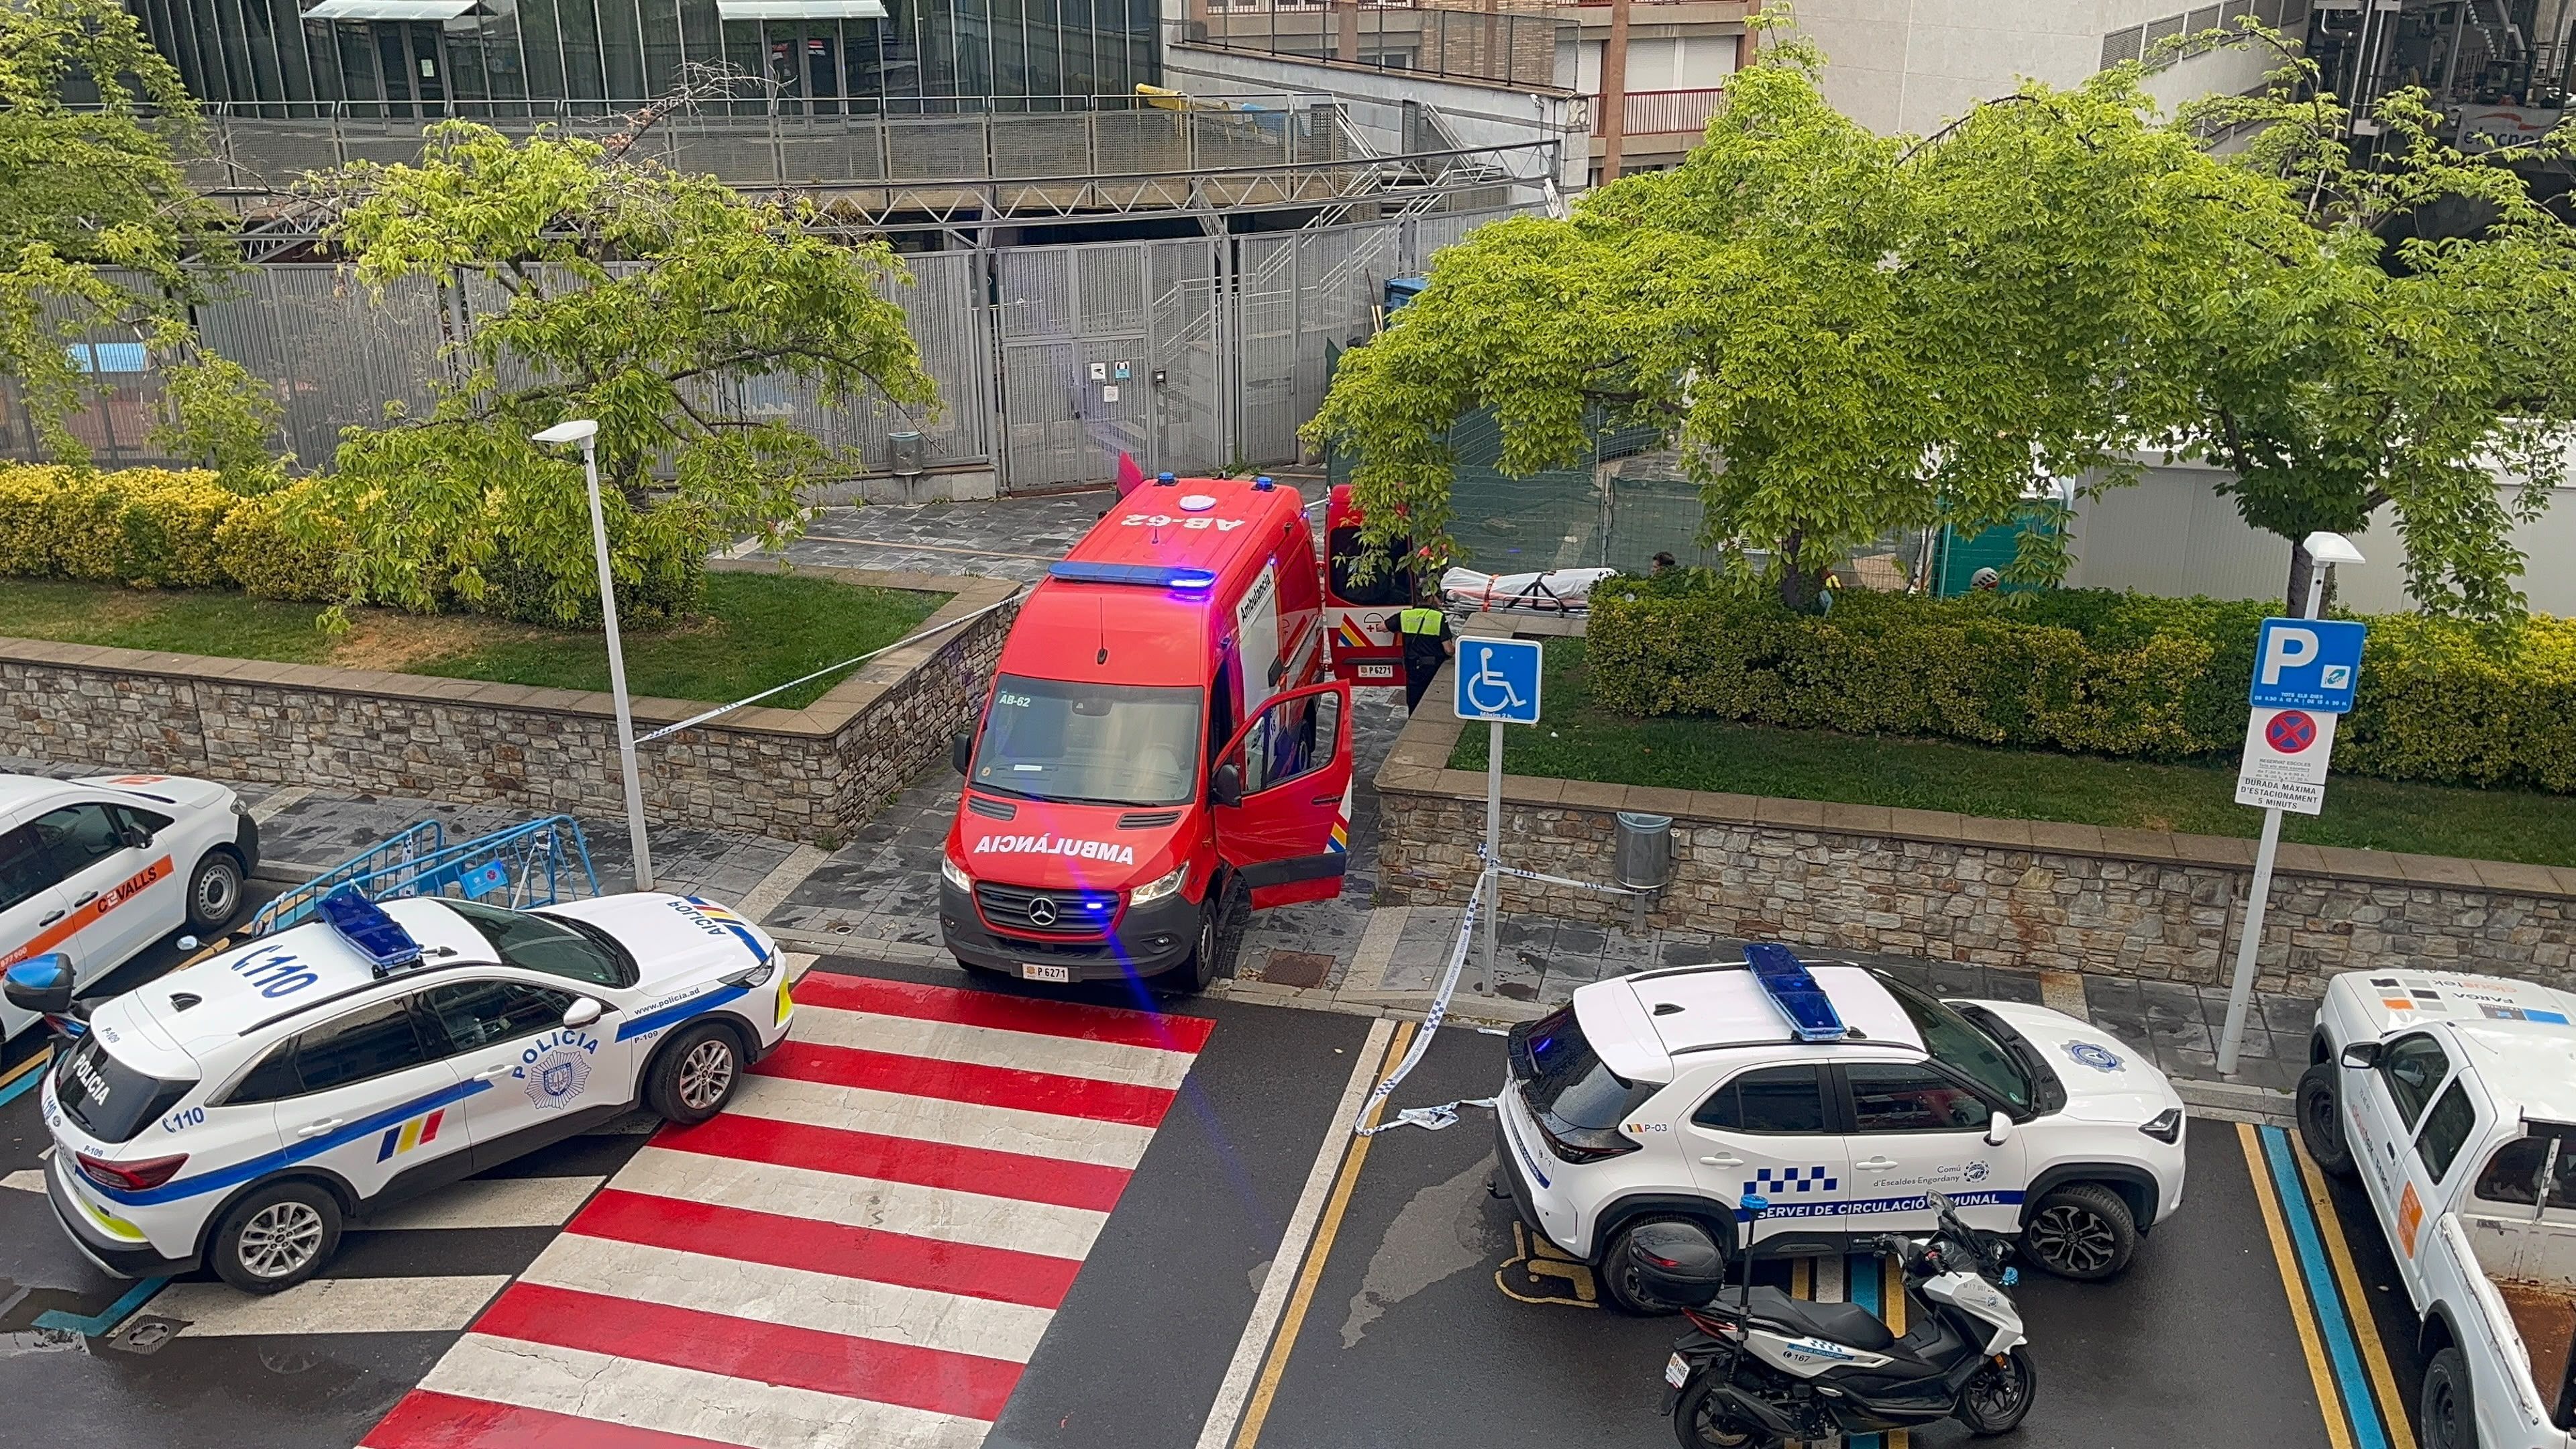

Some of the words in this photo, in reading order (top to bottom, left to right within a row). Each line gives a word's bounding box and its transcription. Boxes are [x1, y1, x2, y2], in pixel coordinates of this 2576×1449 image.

[1121, 514, 1245, 531] AB-62
[2261, 627, 2319, 685] P
[998, 694, 1030, 708] AB-62
[2241, 786, 2318, 804] D'ESTACIONAMENT
[2245, 778, 2279, 790] DURADA
[2282, 783, 2316, 795] MÀXIMA
[2265, 798, 2298, 810] MINUTS
[667, 900, 727, 936] POLICIA
[244, 955, 319, 999] 110
[1038, 967, 1043, 977] P
[1044, 967, 1066, 978] 6271
[633, 987, 700, 1016] www.policia.ad
[102, 1027, 121, 1044] P-109
[634, 1030, 659, 1044] P-109
[511, 1029, 600, 1080] POLICIA
[72, 1053, 111, 1107] POLICIA
[174, 1106, 205, 1130] 110
[1644, 1124, 1668, 1133] P-03
[84, 1144, 104, 1158] P-109
[1937, 1165, 1962, 1174] Comú
[1757, 1206, 1810, 1219] SERVEI
[1814, 1205, 1834, 1216] DE
[1837, 1197, 1926, 1214] CIRCULACIÓ
[1949, 1193, 2000, 1206] MUNAL
[1794, 1354, 1811, 1362] 167
